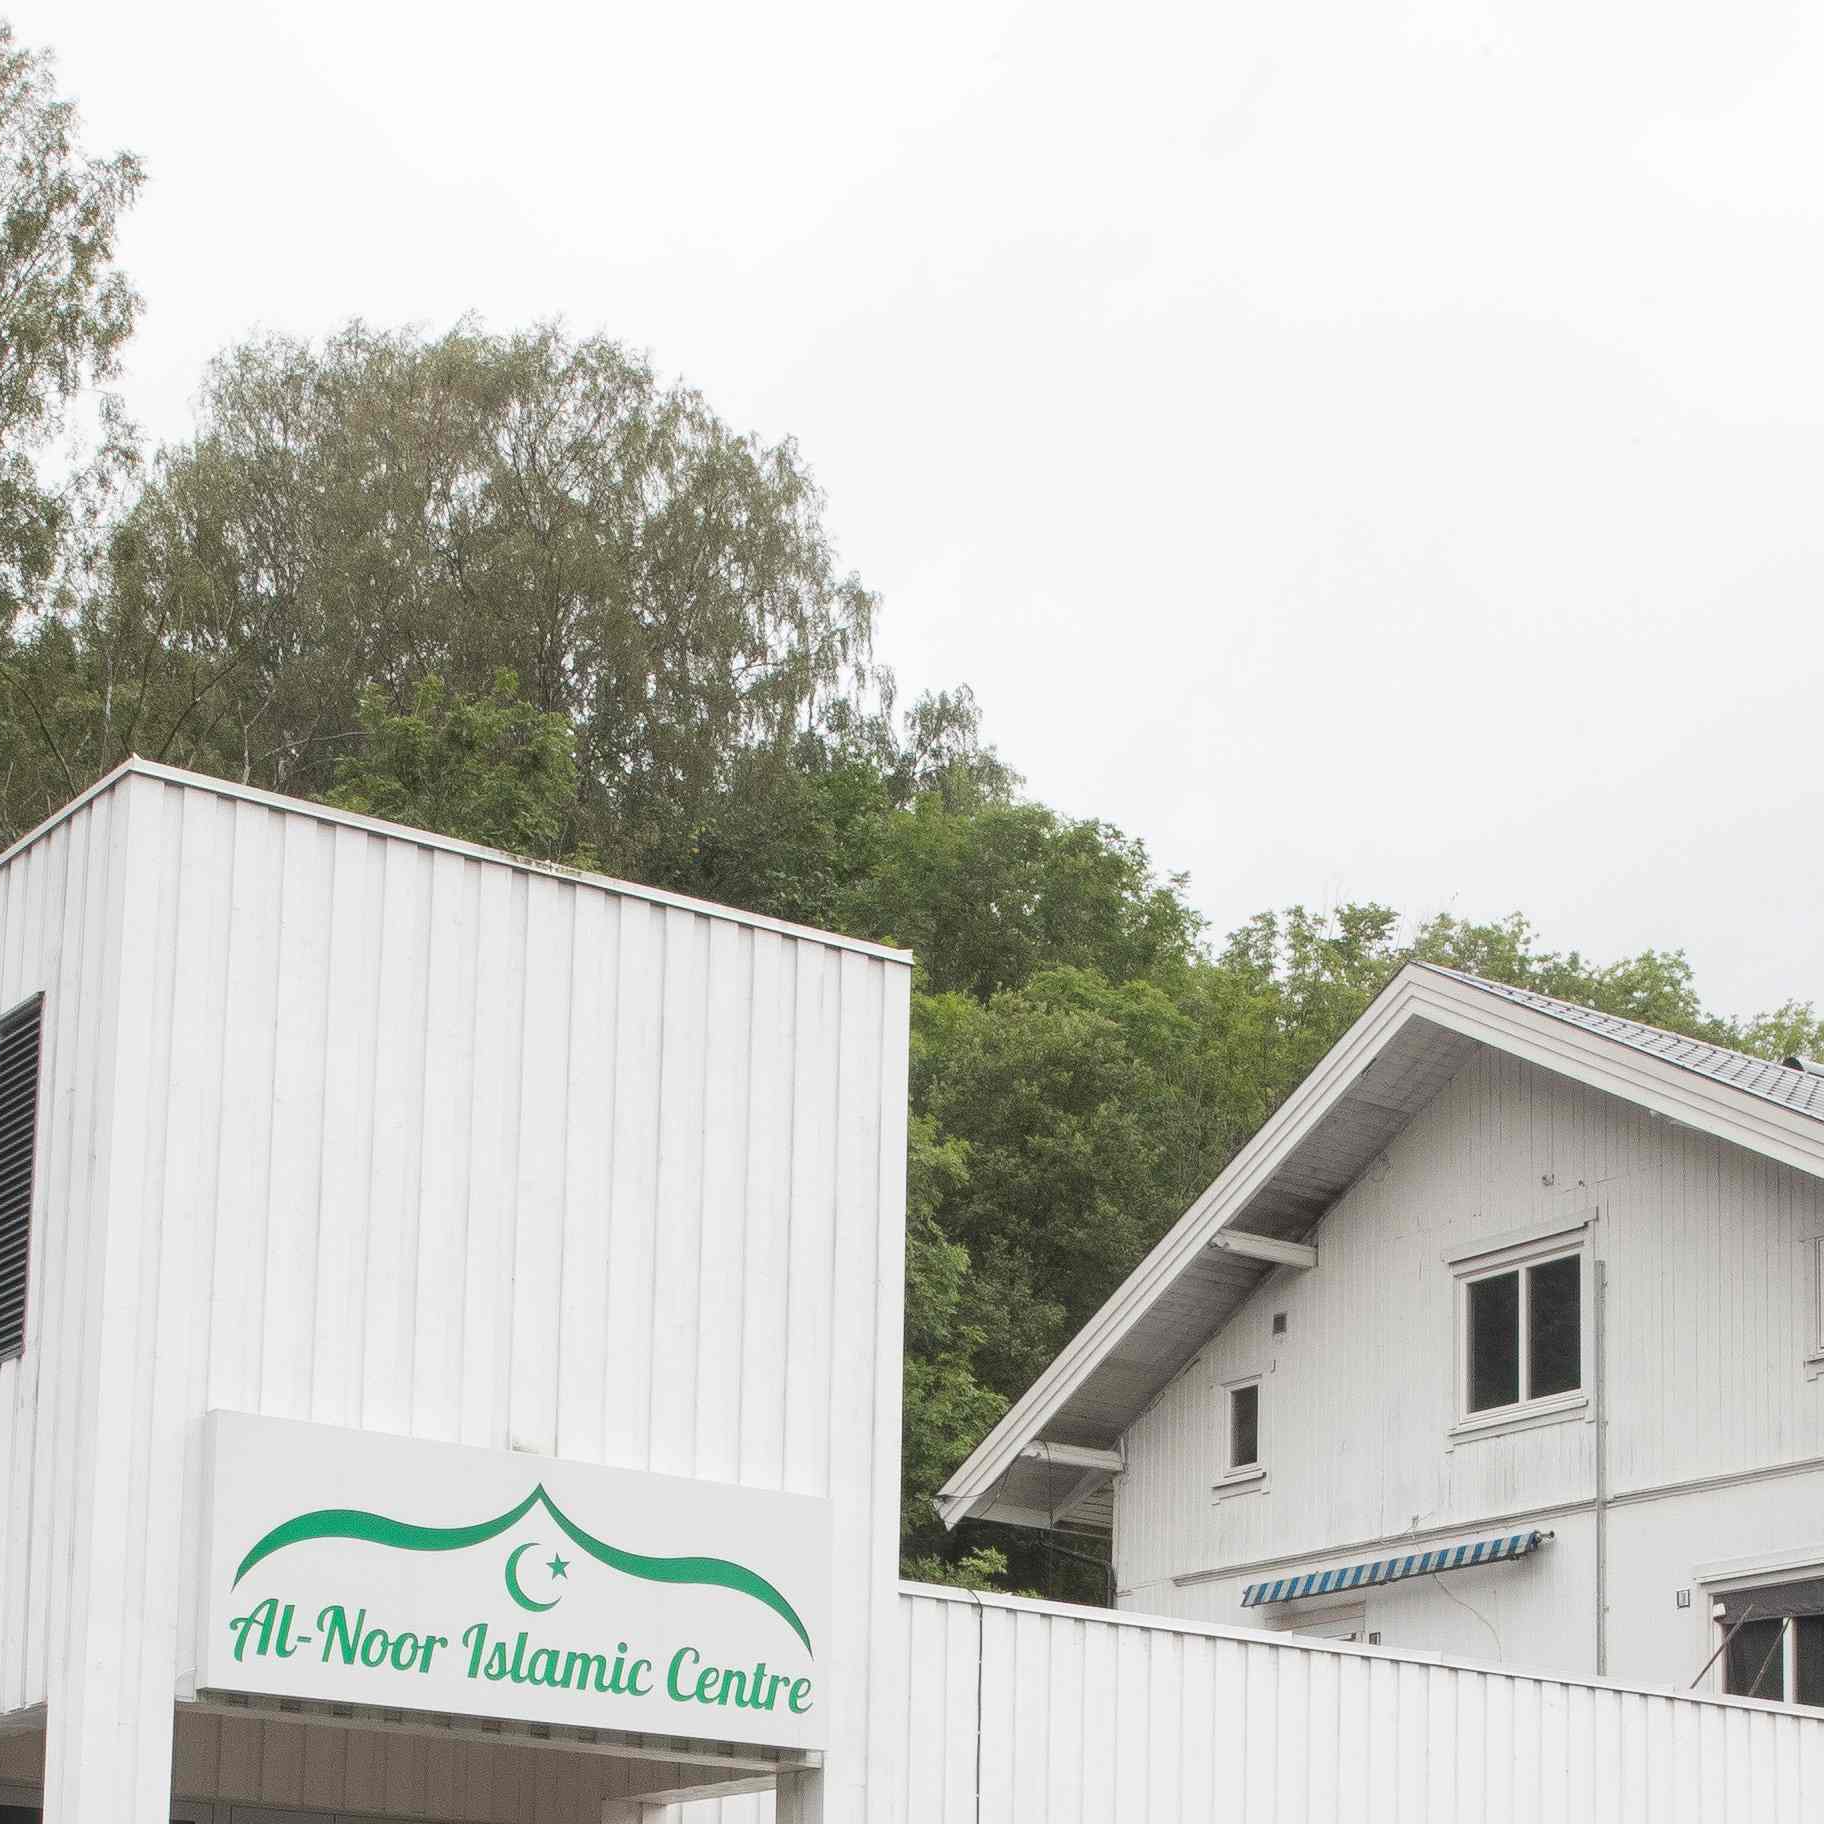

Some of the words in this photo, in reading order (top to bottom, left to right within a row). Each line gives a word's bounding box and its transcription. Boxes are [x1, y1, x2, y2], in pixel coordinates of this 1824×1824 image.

[229, 1596, 448, 1675] Al-Noor
[461, 1622, 654, 1697] Islamic
[666, 1645, 814, 1715] Centre
